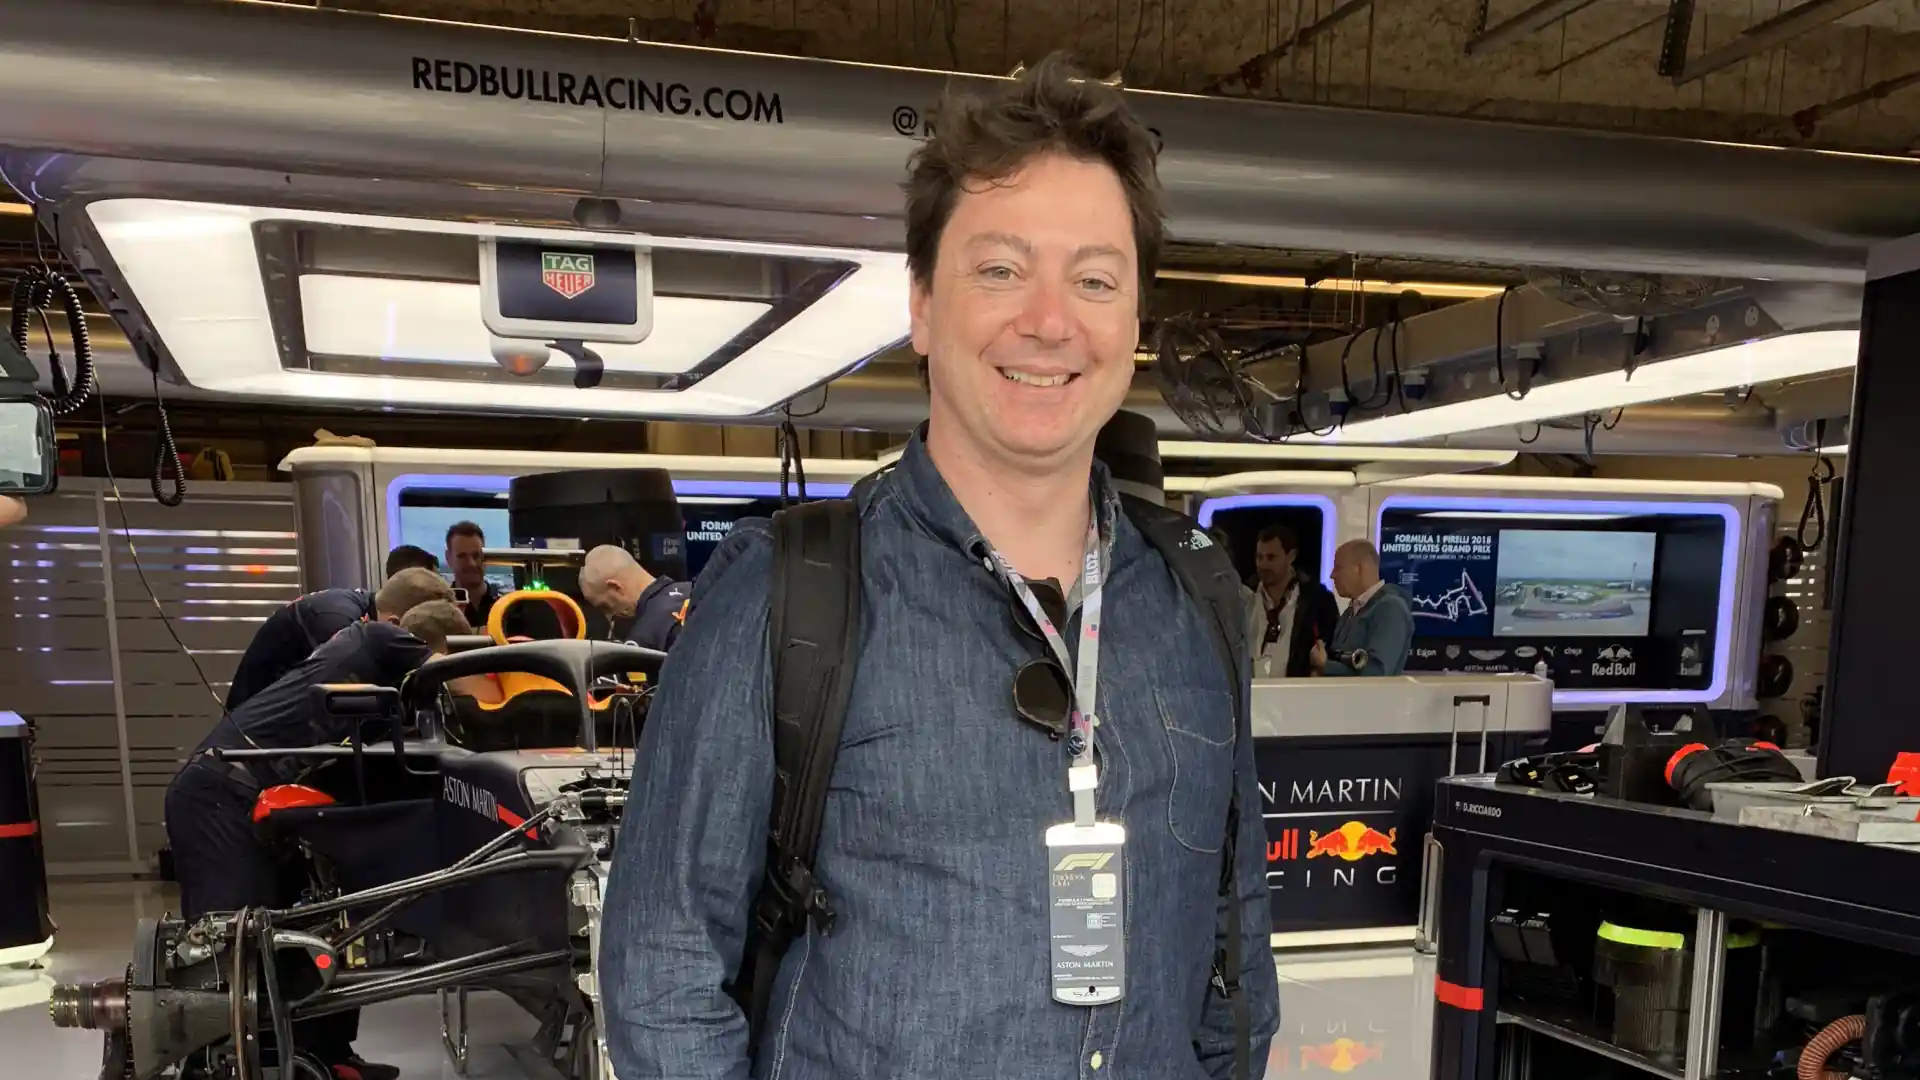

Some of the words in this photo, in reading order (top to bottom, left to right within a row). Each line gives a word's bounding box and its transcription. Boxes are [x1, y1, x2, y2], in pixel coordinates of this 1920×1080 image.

[411, 56, 784, 124] REDBULLRACING.COM
[546, 255, 589, 271] TAG
[546, 272, 593, 294] HEUER
[687, 531, 723, 541] UNITED
[1394, 534, 1434, 543] FORMULA
[1436, 535, 1440, 543] 1
[1443, 535, 1470, 544] PIRELLI
[1471, 535, 1492, 544] 2018
[1382, 543, 1411, 552] UNITED
[1413, 544, 1440, 553] STATES
[1441, 544, 1471, 553] GRAND
[1472, 544, 1491, 553] PRIX
[1591, 662, 1614, 676] Red
[1614, 662, 1636, 676] Bull
[443, 774, 470, 808] ASTON
[472, 783, 498, 824] MARTIN
[1290, 778, 1402, 804] MARTIN
[1266, 828, 1299, 860] ull
[1266, 866, 1397, 890] CING
[1055, 961, 1081, 969] ASTON
[1083, 960, 1114, 968] MARTIN
